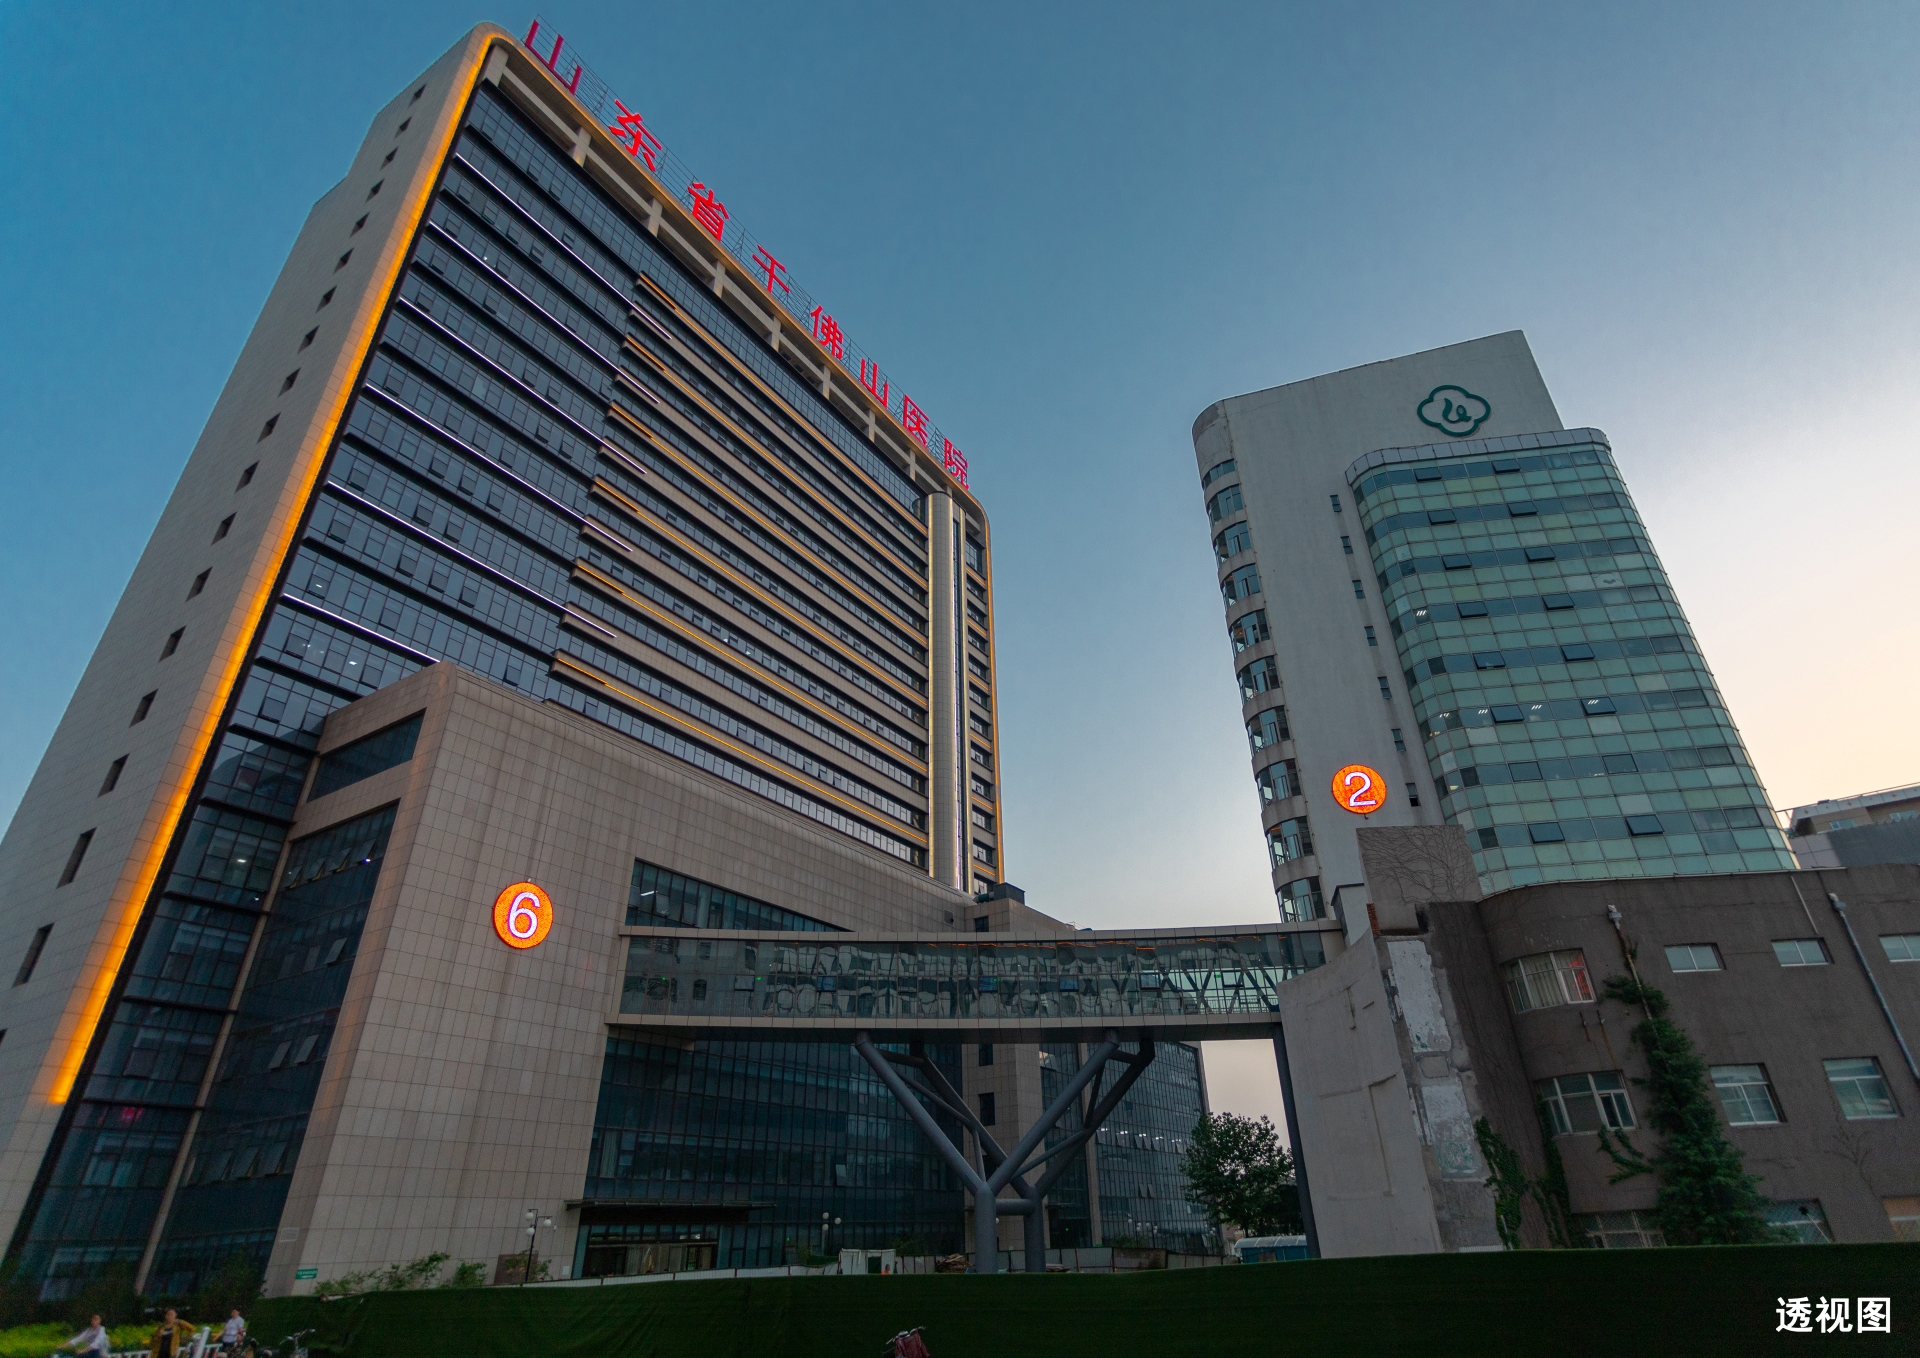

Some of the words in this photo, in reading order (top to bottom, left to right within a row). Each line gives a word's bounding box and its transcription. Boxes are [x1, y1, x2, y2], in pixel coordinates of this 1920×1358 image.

[525, 19, 969, 490] 山东省千佛山医院
[1344, 771, 1377, 807] 2
[508, 891, 540, 939] 6
